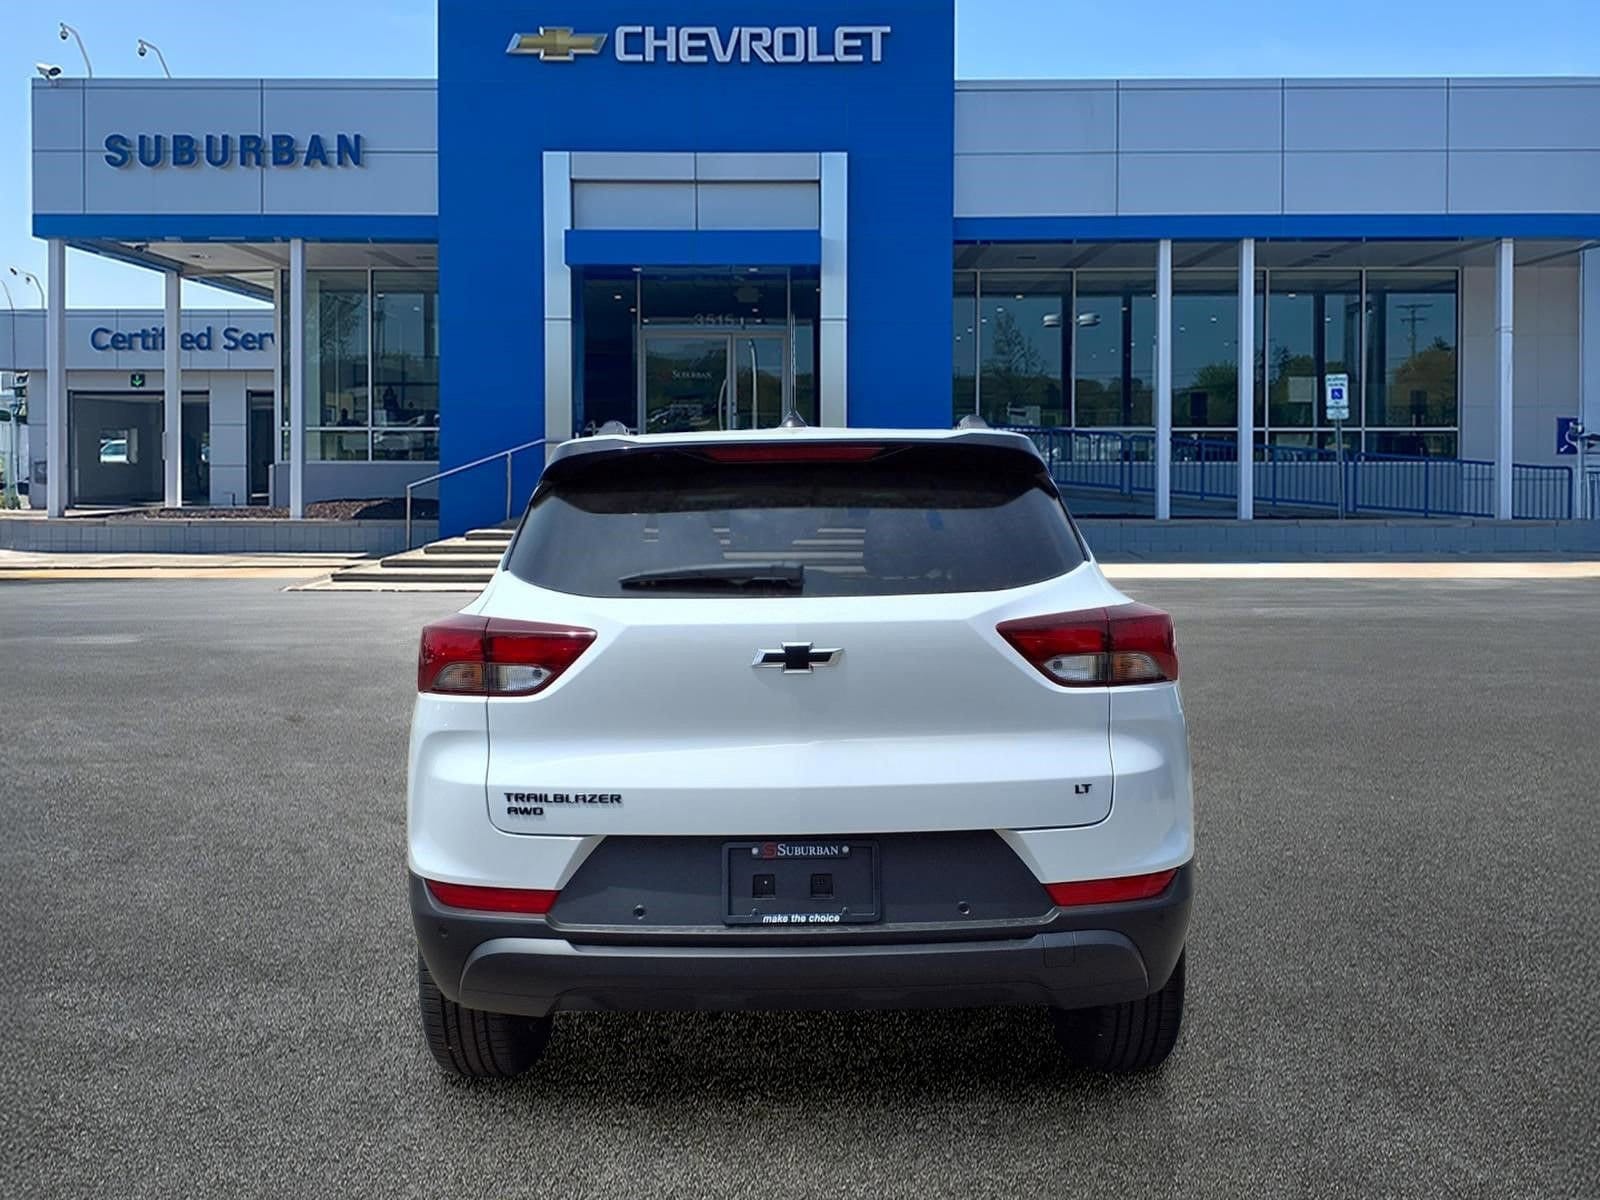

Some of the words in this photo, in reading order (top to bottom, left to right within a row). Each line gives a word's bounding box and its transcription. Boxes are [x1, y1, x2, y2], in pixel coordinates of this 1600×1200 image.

[614, 25, 892, 63] CHEVROLET
[104, 133, 363, 168] SUBURBAN
[1074, 783, 1092, 794] LT
[503, 792, 622, 804] TRAILBLAZER
[506, 806, 544, 816] AWD
[777, 843, 839, 856] SUBURBAN
[762, 914, 789, 923] make
[790, 914, 807, 923] the
[808, 914, 840, 923] choice
